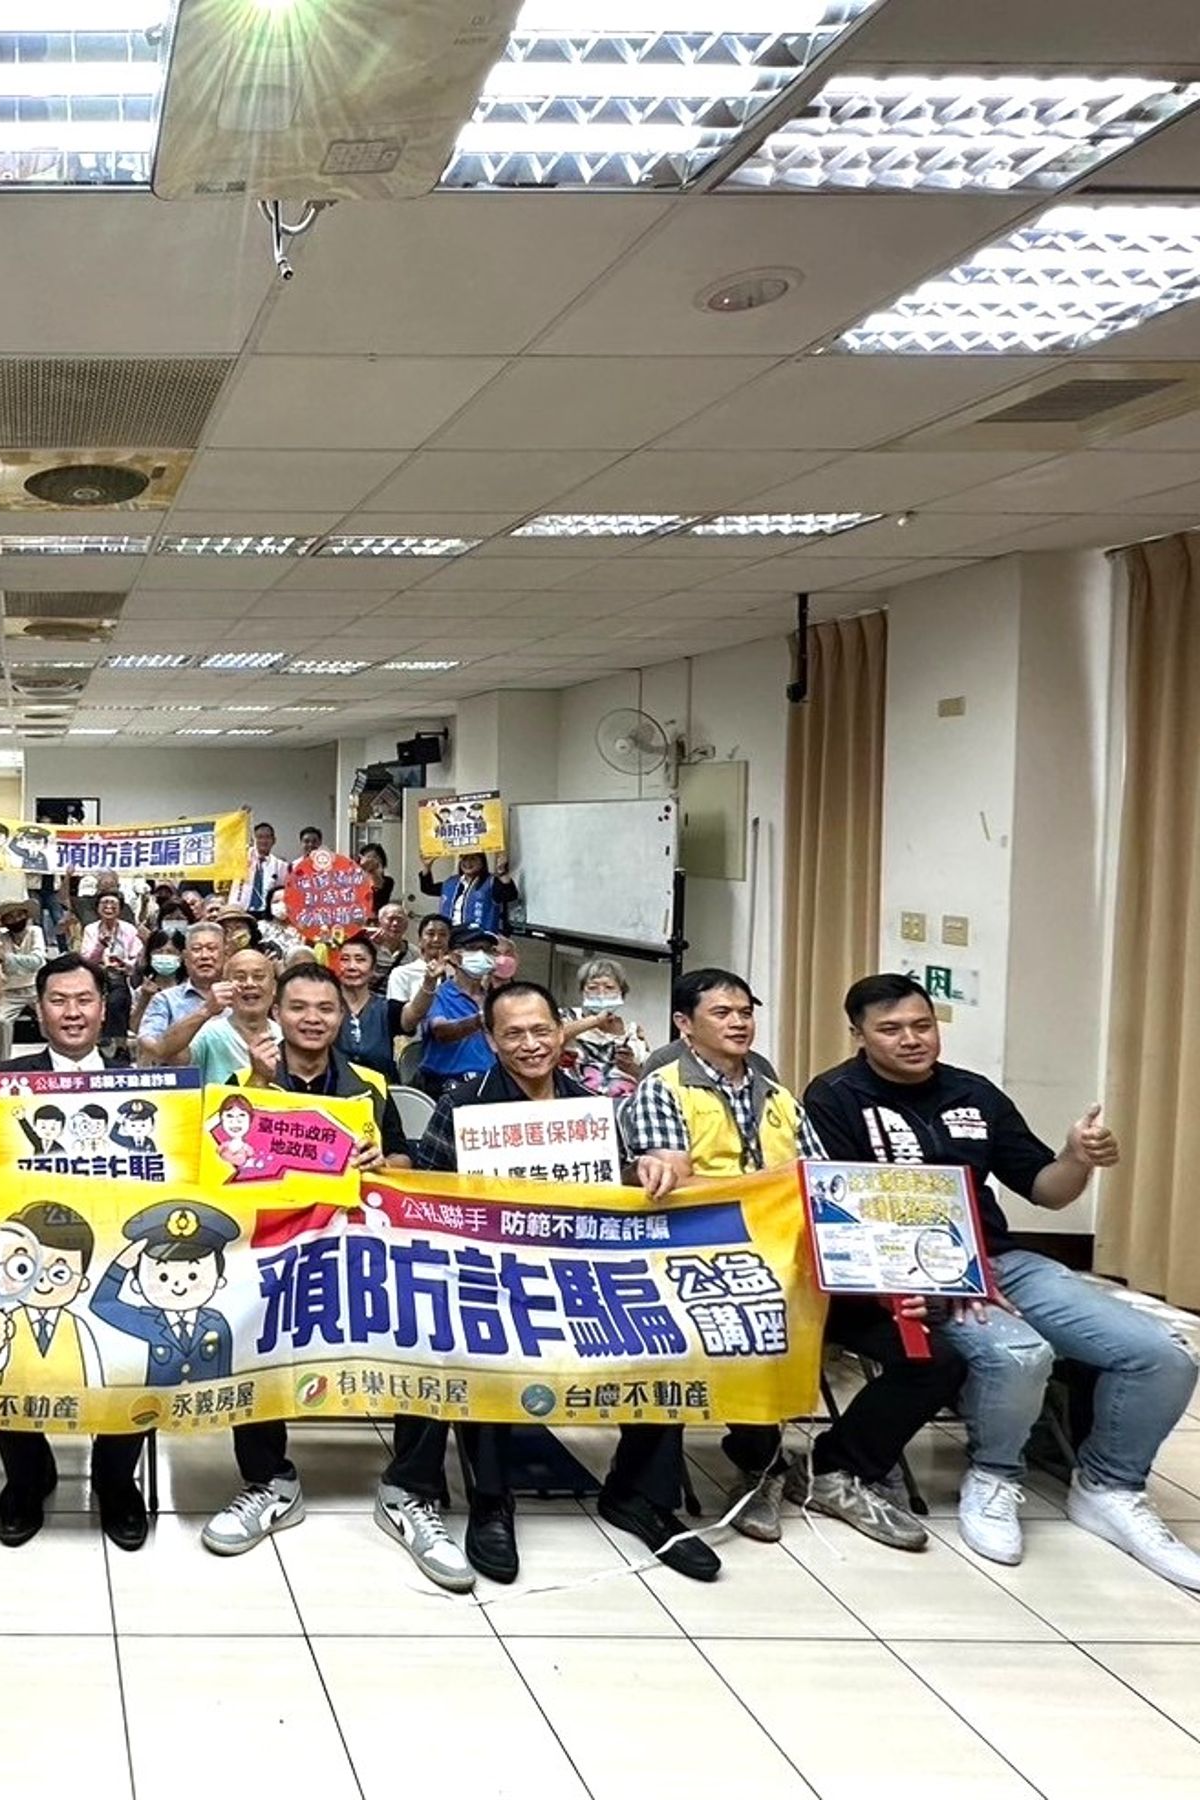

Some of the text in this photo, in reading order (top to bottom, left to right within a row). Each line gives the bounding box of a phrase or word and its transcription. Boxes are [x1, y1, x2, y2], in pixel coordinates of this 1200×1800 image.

[56, 838, 180, 869] 預防詐騙
[35, 1073, 177, 1091] 公私聯手 防範不動產詐騙
[257, 1116, 338, 1144] 臺中市政府
[460, 1117, 610, 1151] 住址隱匿保障好
[270, 1138, 317, 1160] 地政局
[468, 1159, 614, 1183] 廣告免打擾
[401, 1198, 670, 1241] 公私聯手 防範不動產詐騙
[668, 1253, 779, 1299] 公益
[256, 1235, 687, 1359] 預防詐騙
[691, 1299, 788, 1356] 講座
[172, 1381, 254, 1417] 永義房屋
[336, 1370, 468, 1403] 有巢氏房屋
[564, 1380, 710, 1407] 台慶不動產
